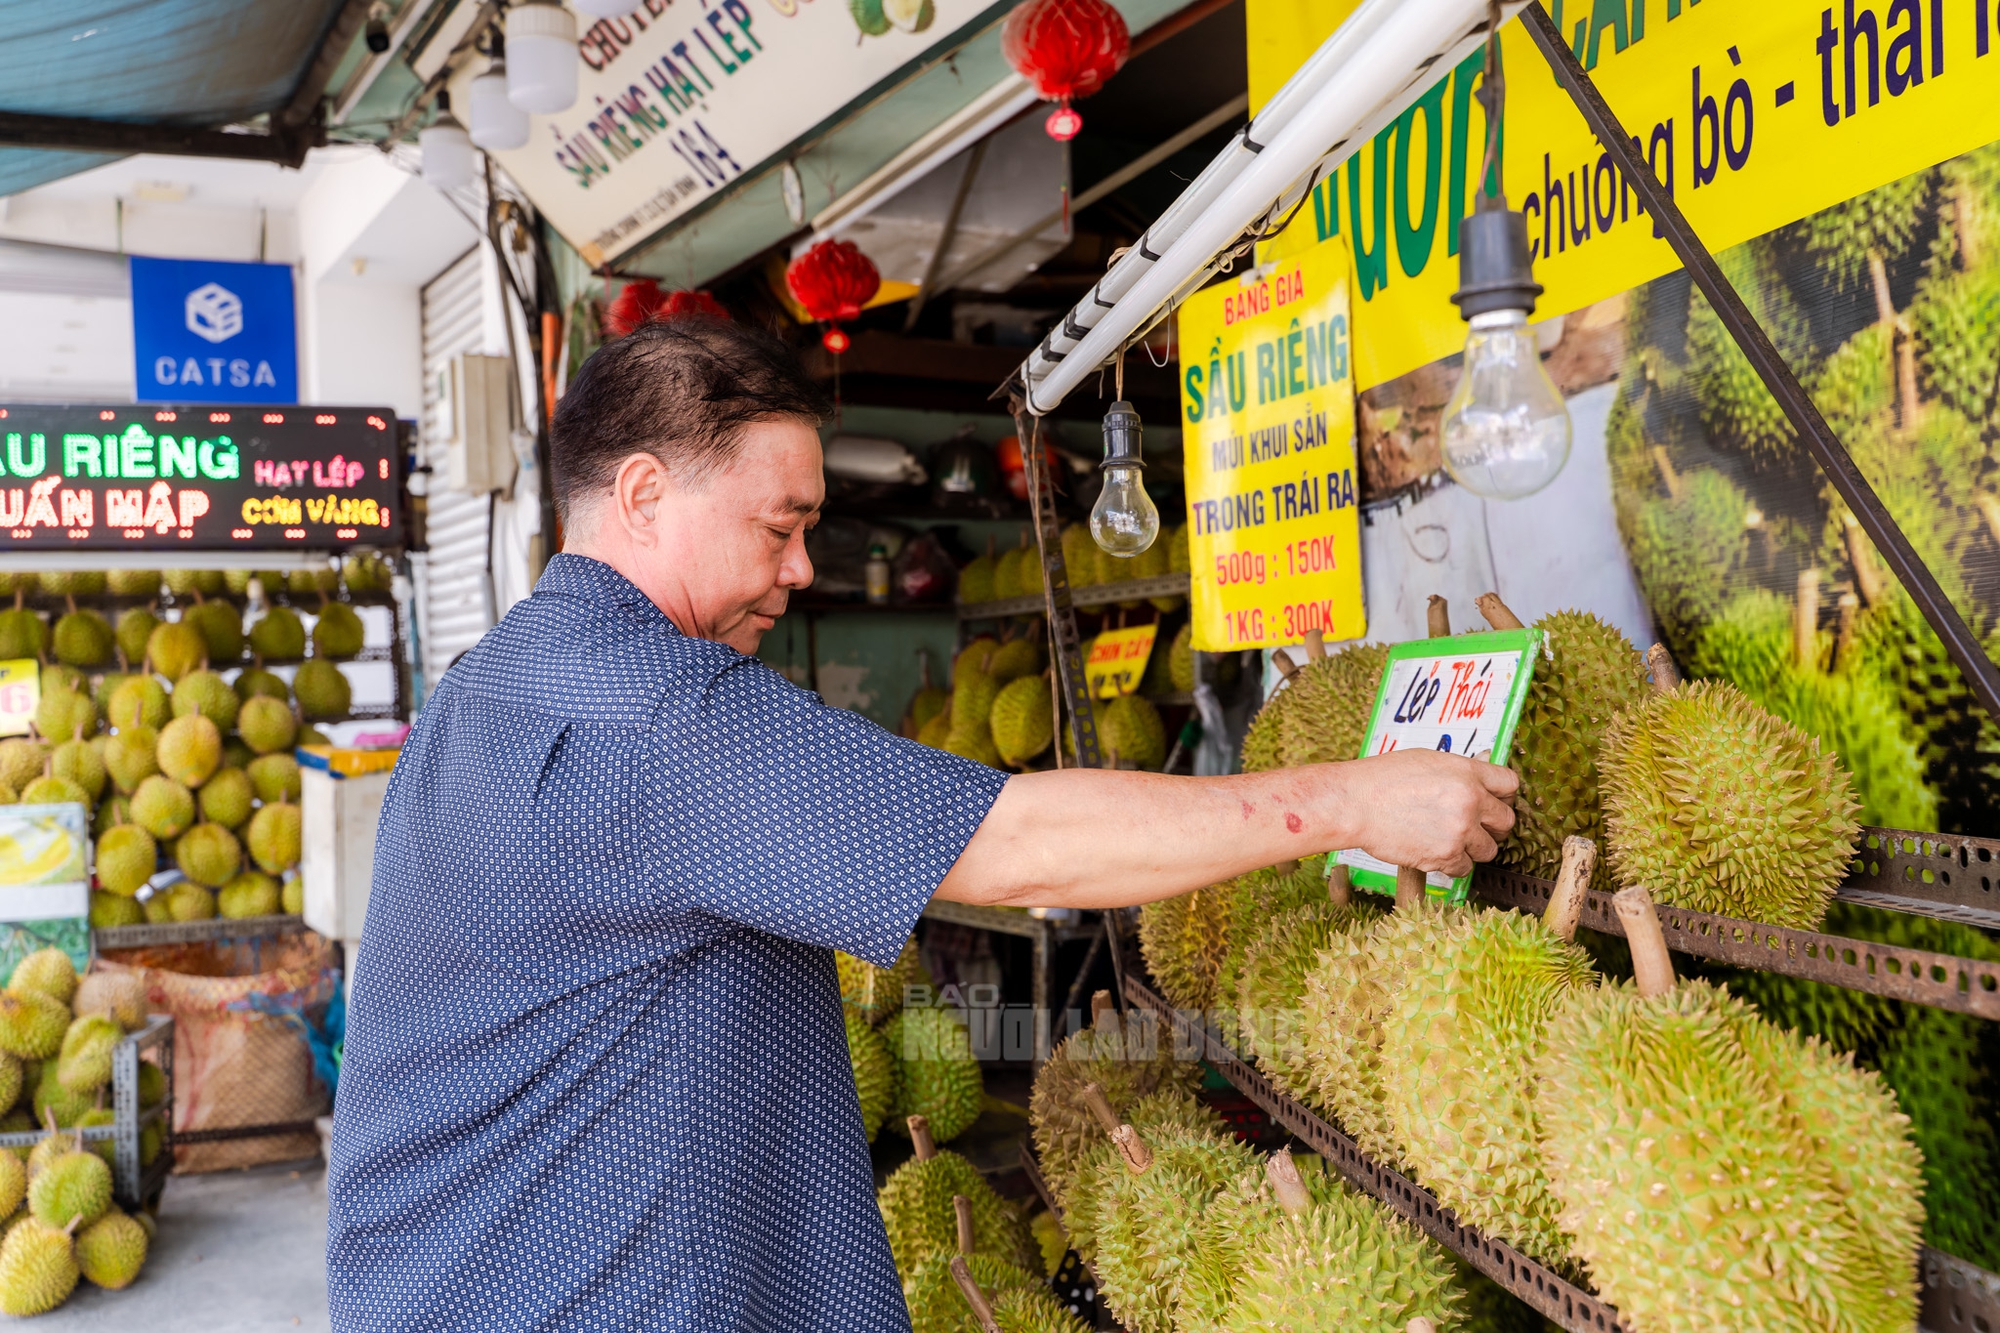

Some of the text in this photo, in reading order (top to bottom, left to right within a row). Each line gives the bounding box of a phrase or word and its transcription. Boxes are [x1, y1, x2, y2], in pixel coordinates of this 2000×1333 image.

[644, 40, 714, 115] HẠT
[1692, 45, 1754, 189] bò
[669, 120, 741, 188] 164
[1276, 262, 1304, 307] GIÁ
[154, 355, 277, 388] CATSA
[1185, 314, 1348, 424] SẦU RIÊNG
[62, 422, 240, 480] RIÊNG
[1212, 430, 1244, 472] MÚI
[1250, 424, 1288, 464] KHUI
[105, 480, 210, 535] MẬP
[1192, 469, 1355, 536] TRONG TRÁI RA
[1216, 550, 1266, 586] 500g
[1286, 534, 1336, 576] 150K
[1225, 608, 1264, 643] 1KG
[1284, 600, 1335, 638] 300K
[1438, 658, 1494, 724] Thái
